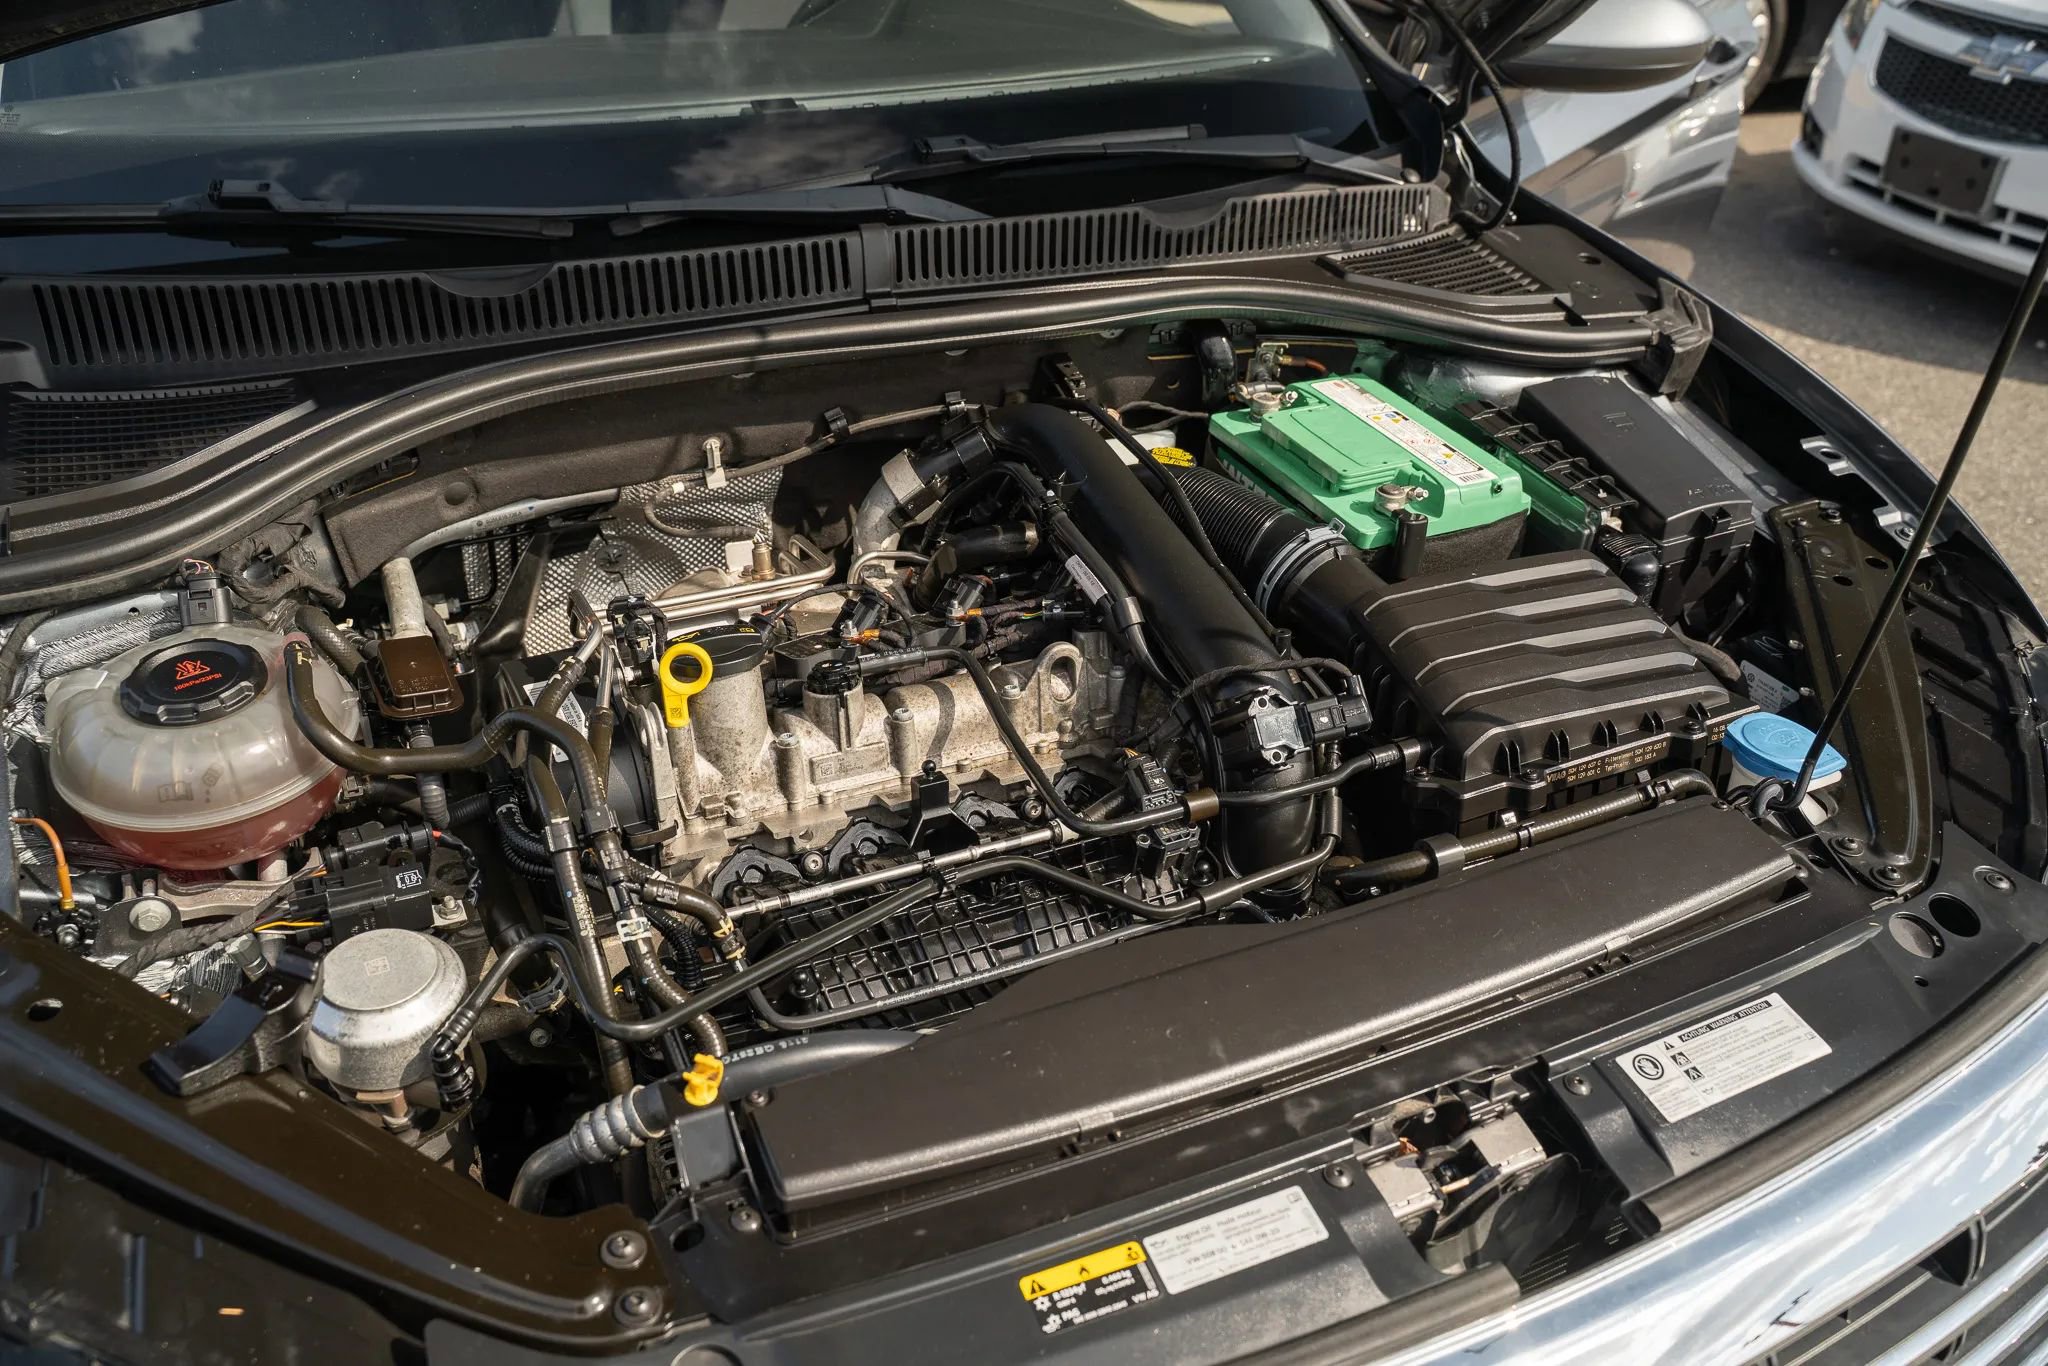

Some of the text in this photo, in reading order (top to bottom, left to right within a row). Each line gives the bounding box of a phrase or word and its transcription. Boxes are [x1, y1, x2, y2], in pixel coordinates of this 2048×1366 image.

[1680, 1001, 1769, 1042] ACHTUNG WARNING ATTENTION
